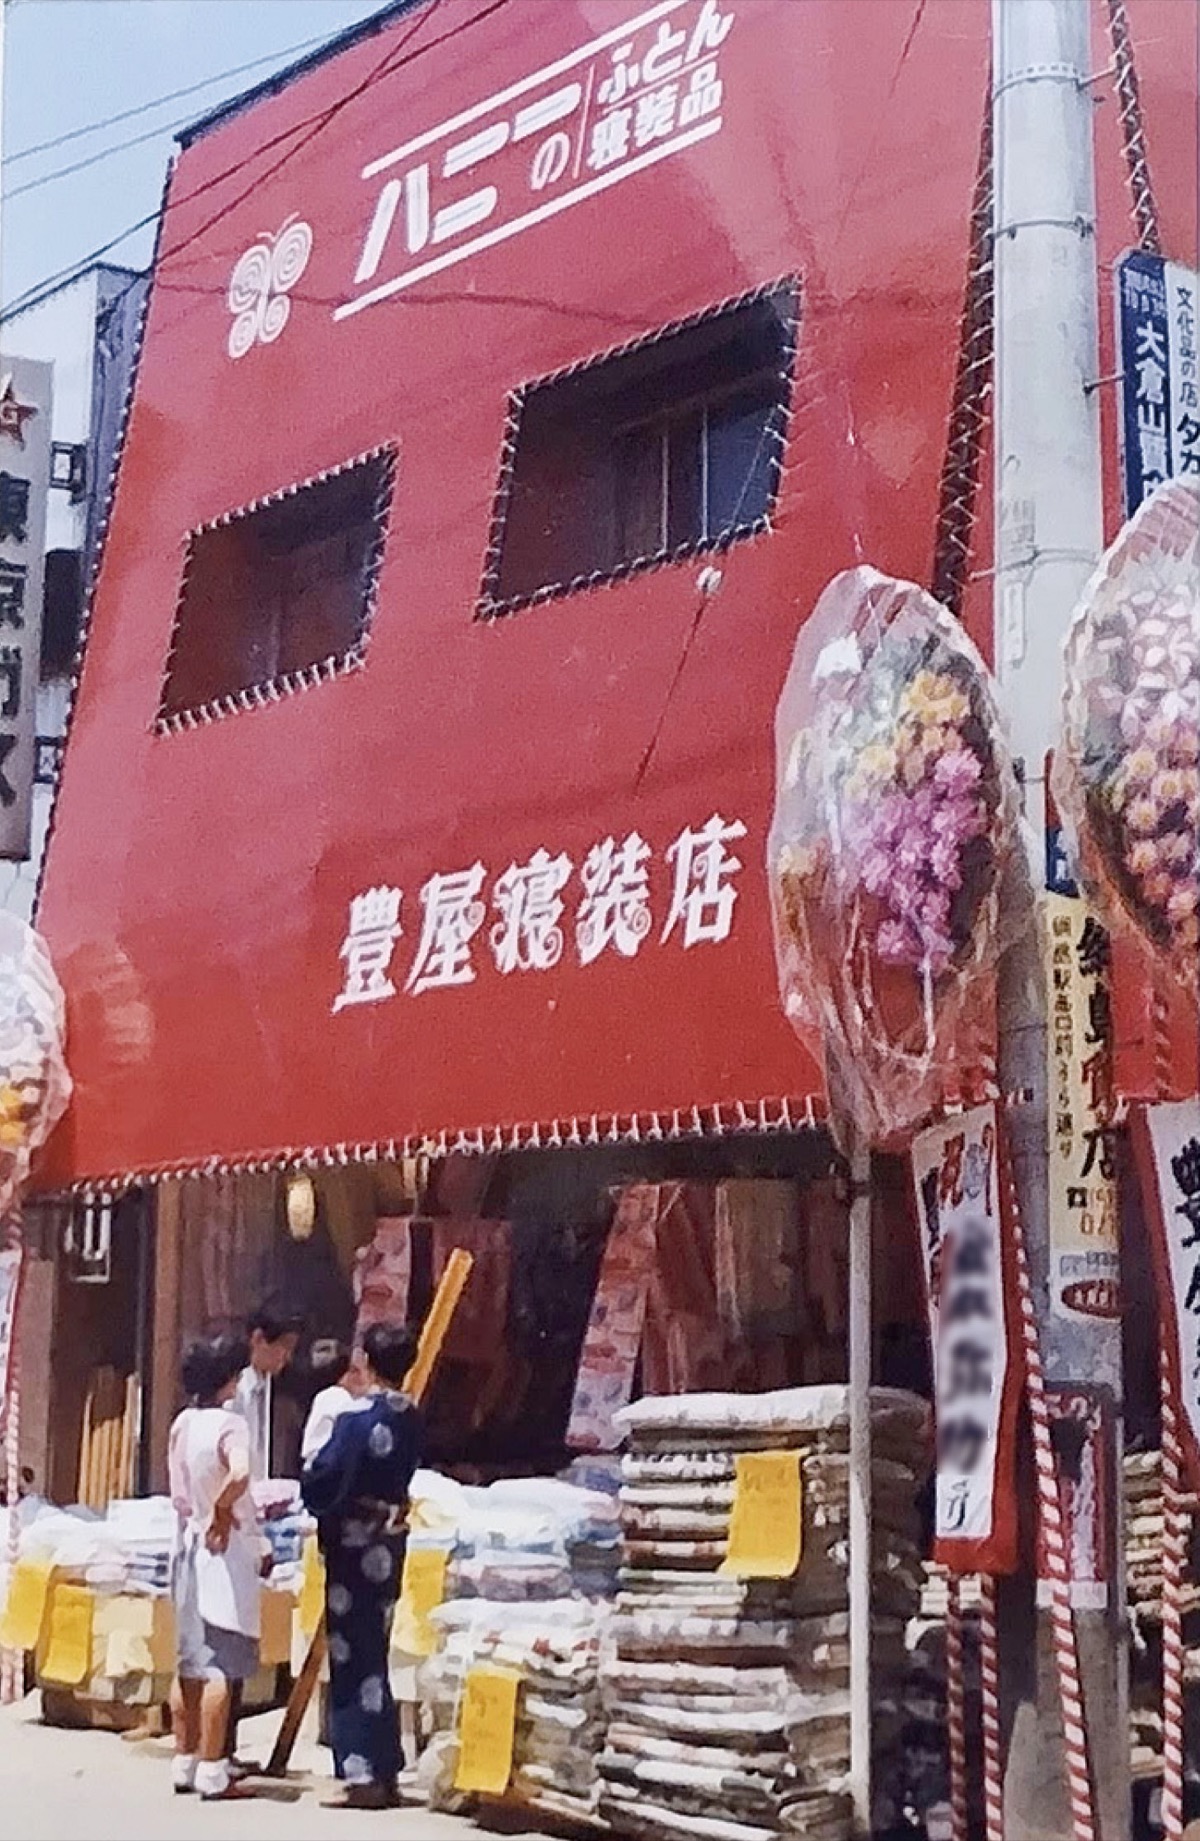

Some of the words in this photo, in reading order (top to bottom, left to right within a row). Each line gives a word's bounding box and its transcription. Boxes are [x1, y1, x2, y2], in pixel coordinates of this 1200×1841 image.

[598, 0, 736, 104] ふとん
[330, 813, 748, 1015] 豊屋寝装店
